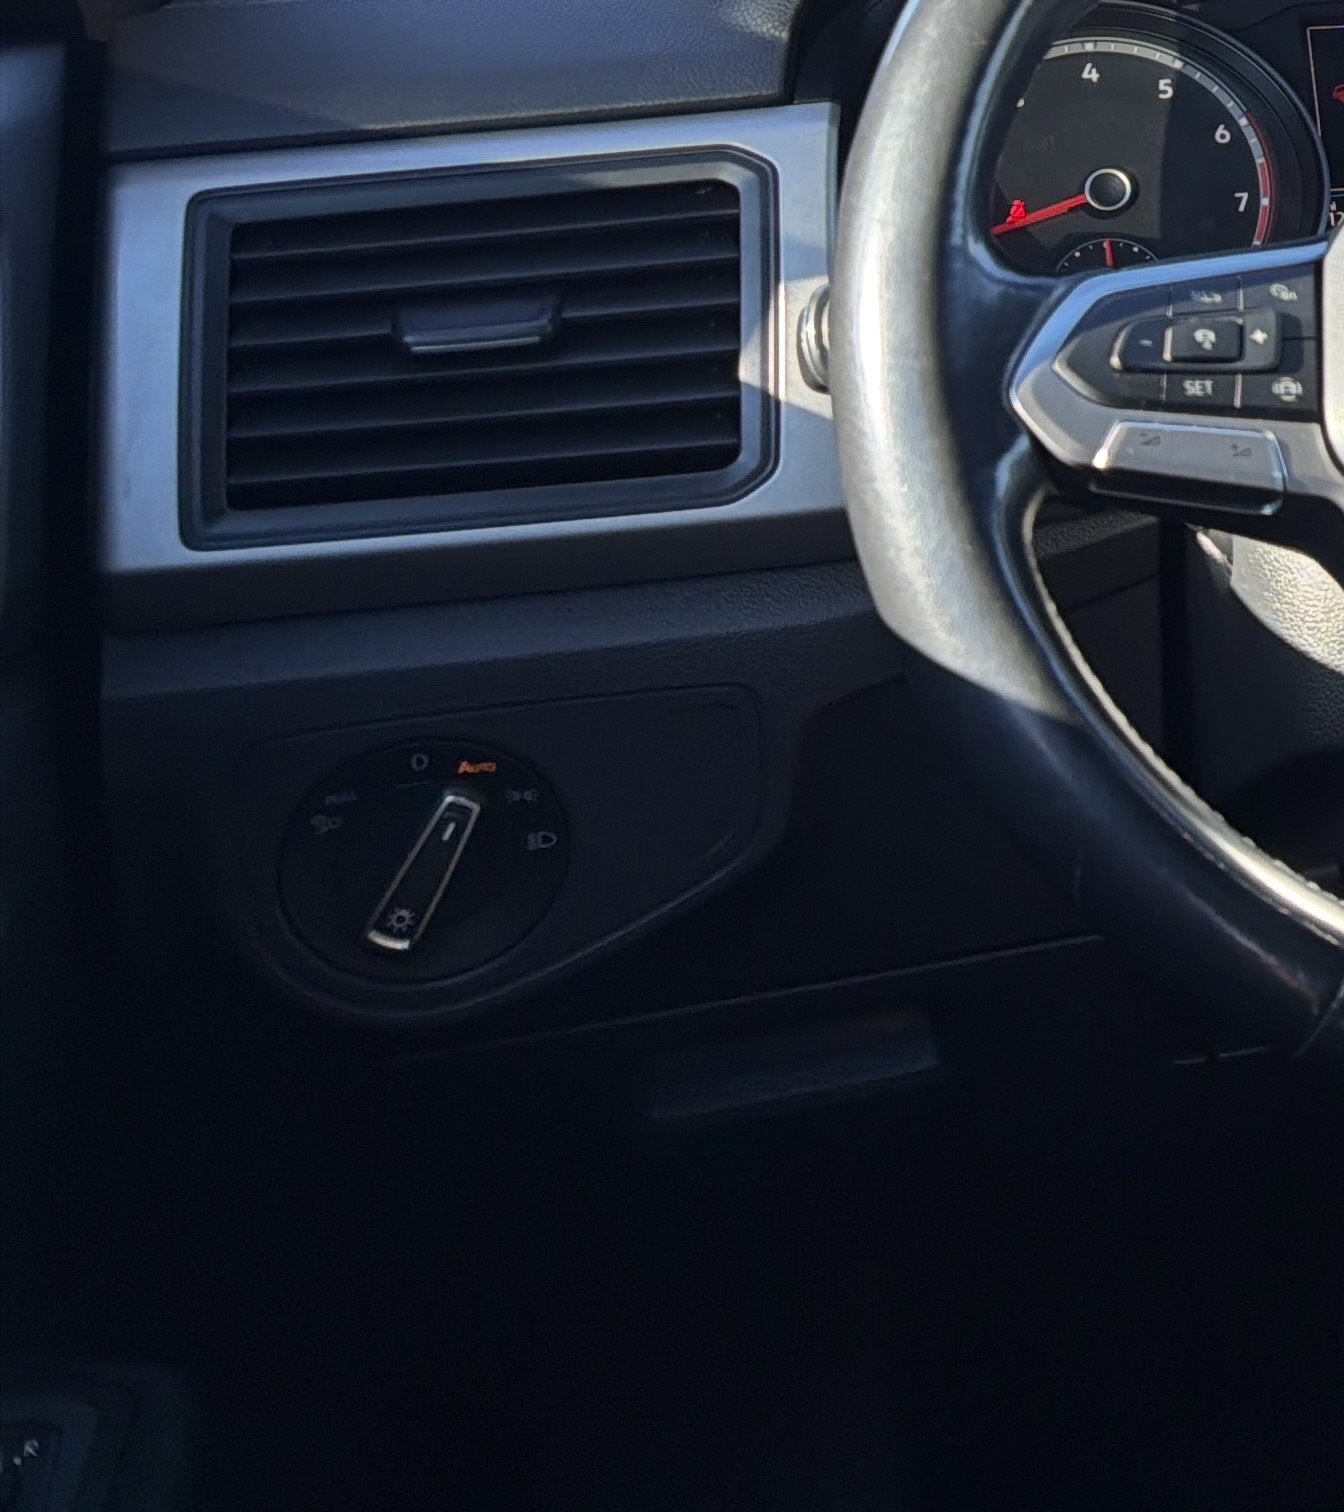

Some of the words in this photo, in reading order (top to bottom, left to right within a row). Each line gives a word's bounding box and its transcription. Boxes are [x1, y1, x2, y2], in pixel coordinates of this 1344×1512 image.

[1081, 63, 1100, 83] 4
[1158, 78, 1174, 100] 5
[1214, 124, 1231, 144] 6
[1234, 192, 1249, 213] 7
[1182, 379, 1215, 397] SET
